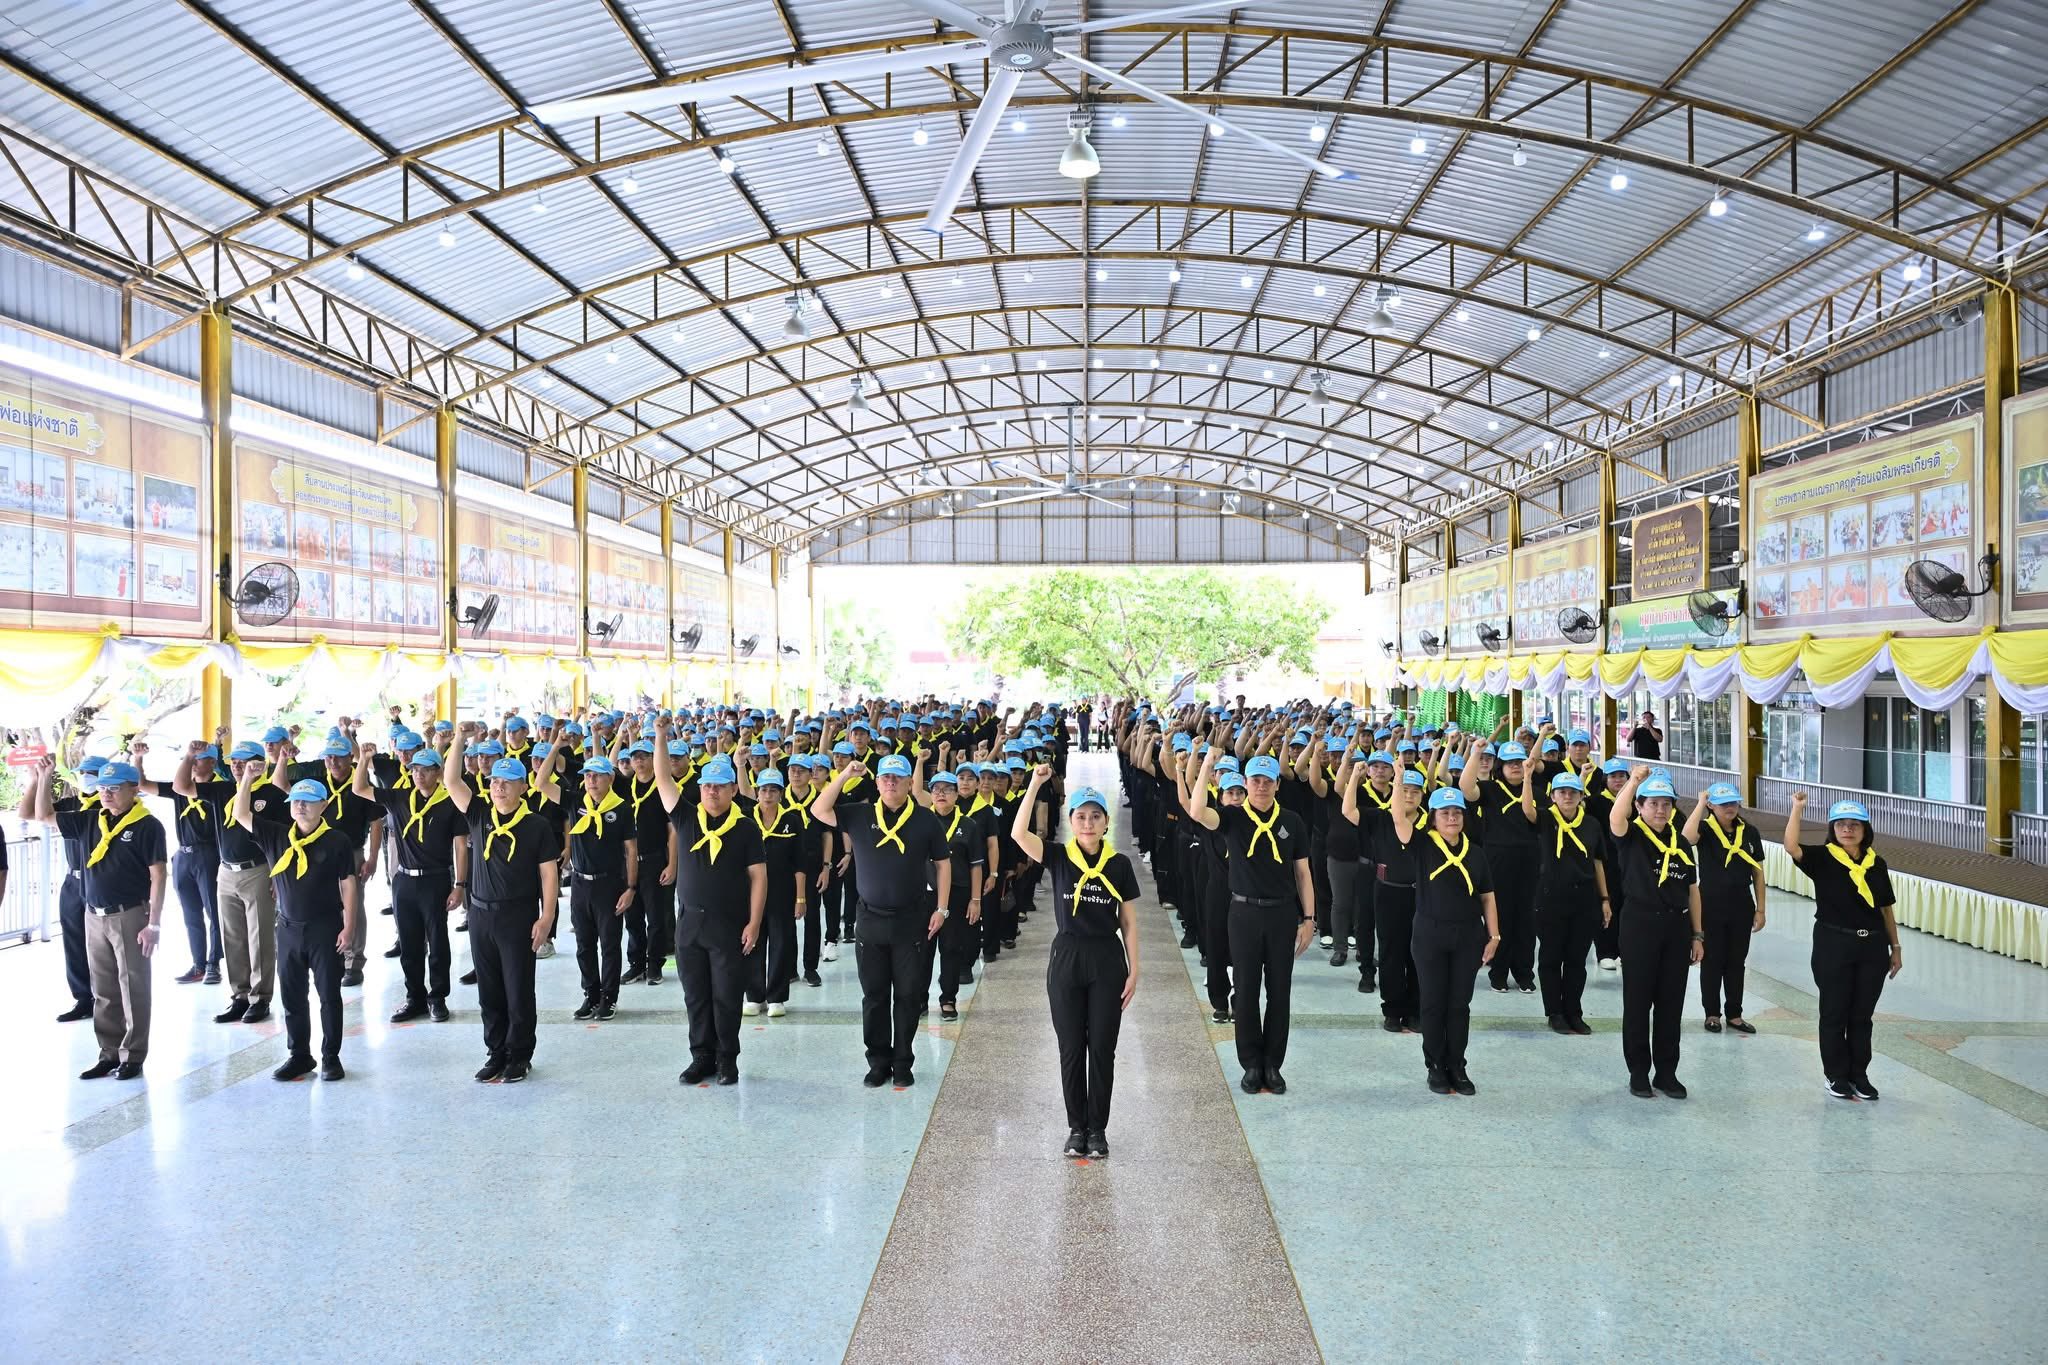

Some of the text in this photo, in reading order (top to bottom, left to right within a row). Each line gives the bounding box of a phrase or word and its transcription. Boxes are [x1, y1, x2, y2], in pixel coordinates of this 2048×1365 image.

[1775, 450, 1942, 507] บรรพชาสามเณรภาคฤดูร้อนเฉลิมพระเกียรติ
